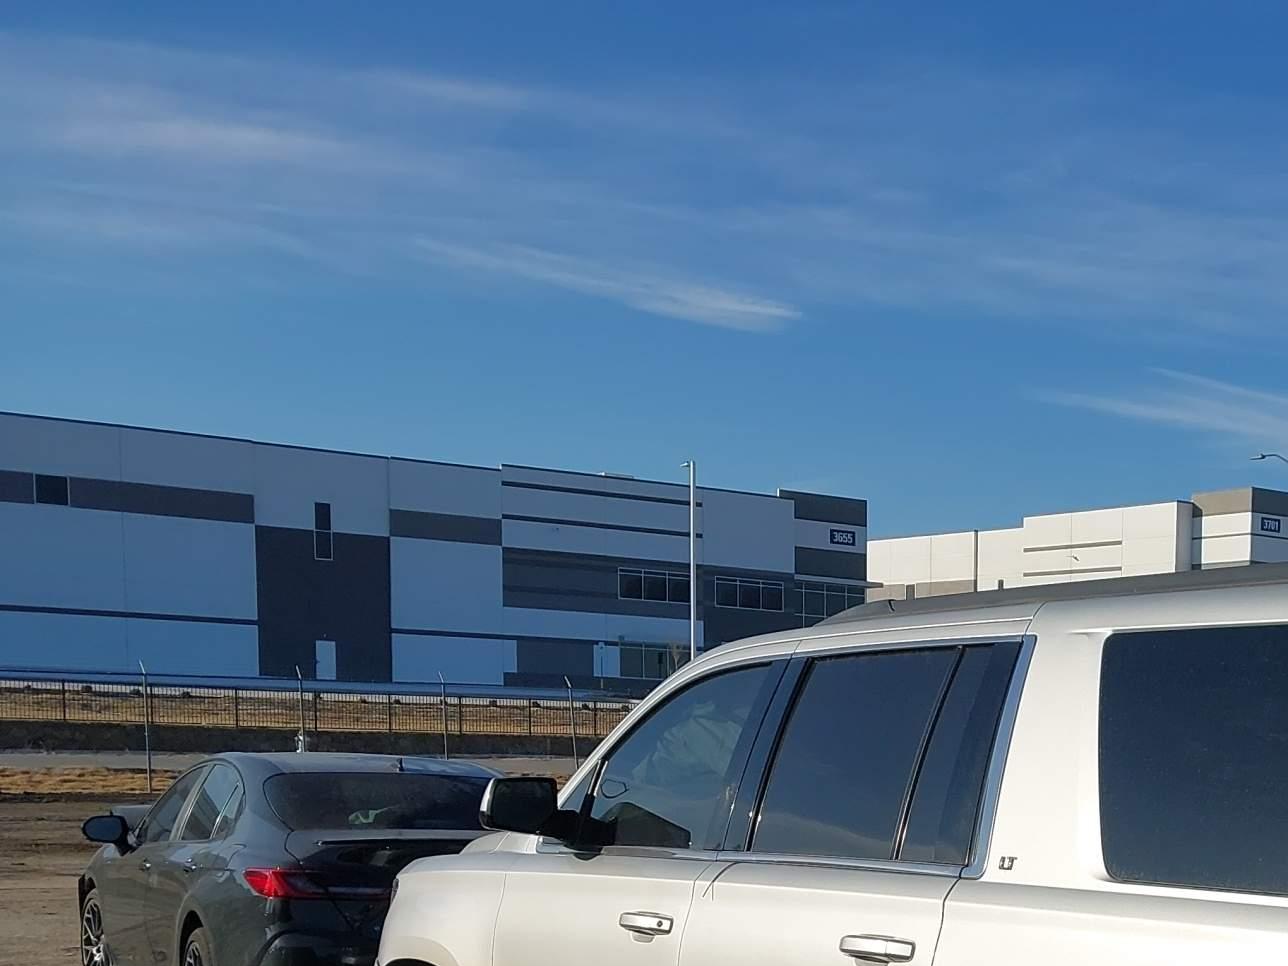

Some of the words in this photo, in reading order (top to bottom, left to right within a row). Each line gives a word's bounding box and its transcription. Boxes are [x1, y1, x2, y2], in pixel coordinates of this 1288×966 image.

[1263, 519, 1279, 531] 3701
[832, 531, 853, 544] 3655
[999, 856, 1018, 870] LT
